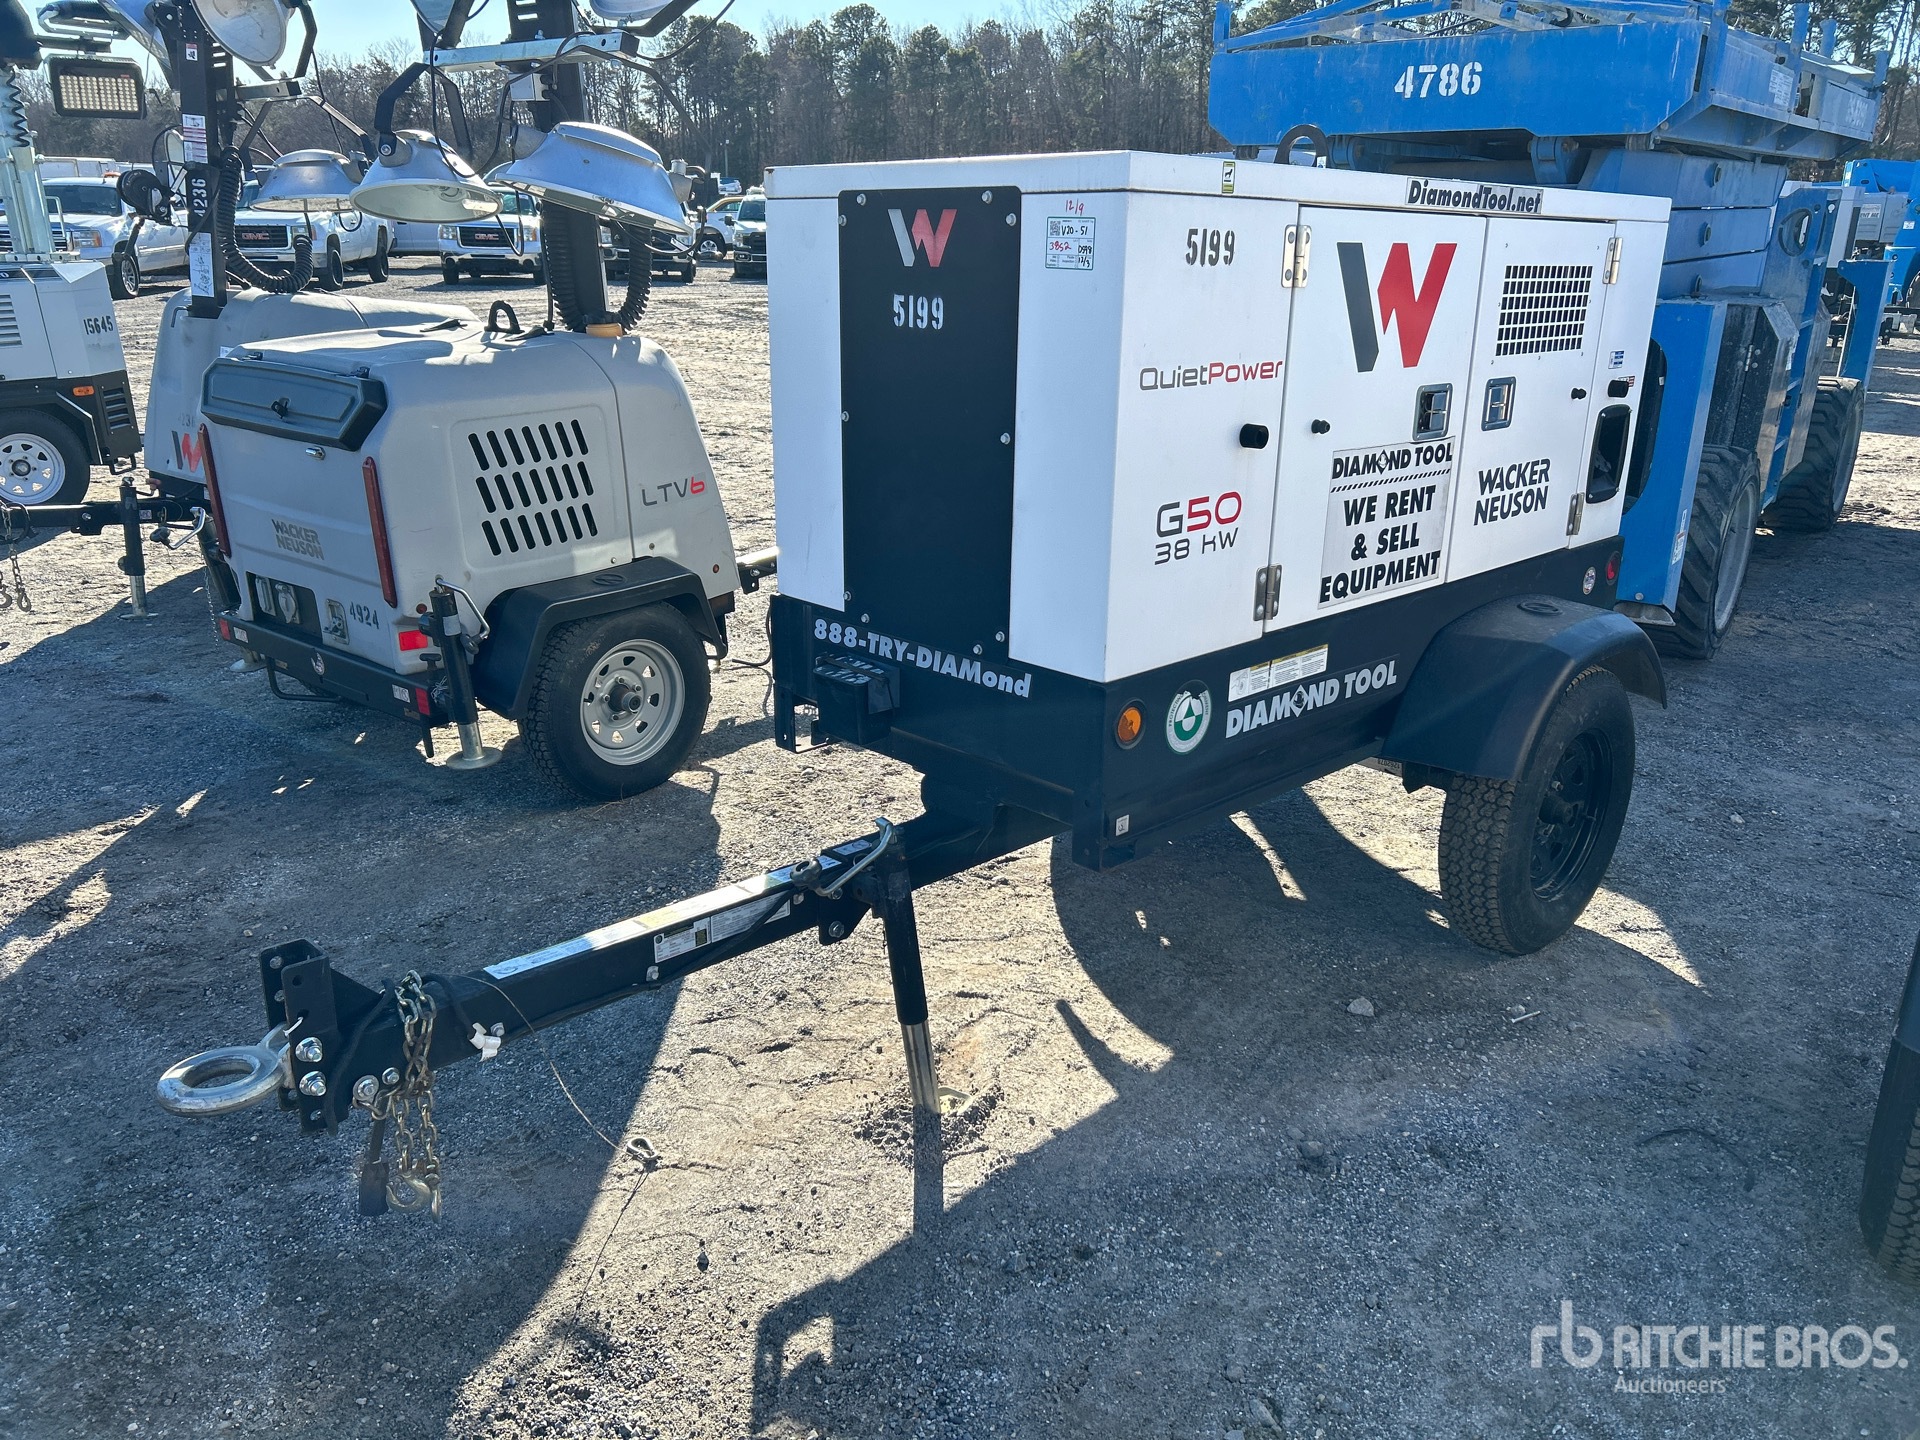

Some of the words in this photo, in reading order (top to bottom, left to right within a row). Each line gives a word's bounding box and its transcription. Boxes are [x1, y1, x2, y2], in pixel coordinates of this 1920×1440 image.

[1394, 62, 1482, 99] 4786
[1407, 179, 1541, 213] DiamondTool.net
[241, 232, 270, 240] GMC
[1185, 228, 1236, 267] 5199
[83, 315, 114, 335] 15645
[893, 294, 944, 330] 5199
[1139, 360, 1283, 391] QuietPower
[1414, 442, 1453, 468] TOOL
[641, 476, 706, 507] LTV6
[1478, 458, 1551, 496] WACKER
[1156, 491, 1243, 538] G50
[1343, 495, 1378, 527] WE
[1384, 484, 1436, 519] RENT
[1473, 485, 1549, 526] NEUSON
[271, 518, 320, 545] WACKER
[276, 534, 324, 560] NEUSON
[1350, 533, 1368, 561] &
[1376, 522, 1420, 556] SELL
[1154, 538, 1190, 566] 38
[1319, 549, 1441, 604] EQUIPMENT
[349, 601, 379, 630] 4924
[814, 618, 1032, 698] 888-TRY-DIAMond
[1344, 660, 1398, 699] TOOL
